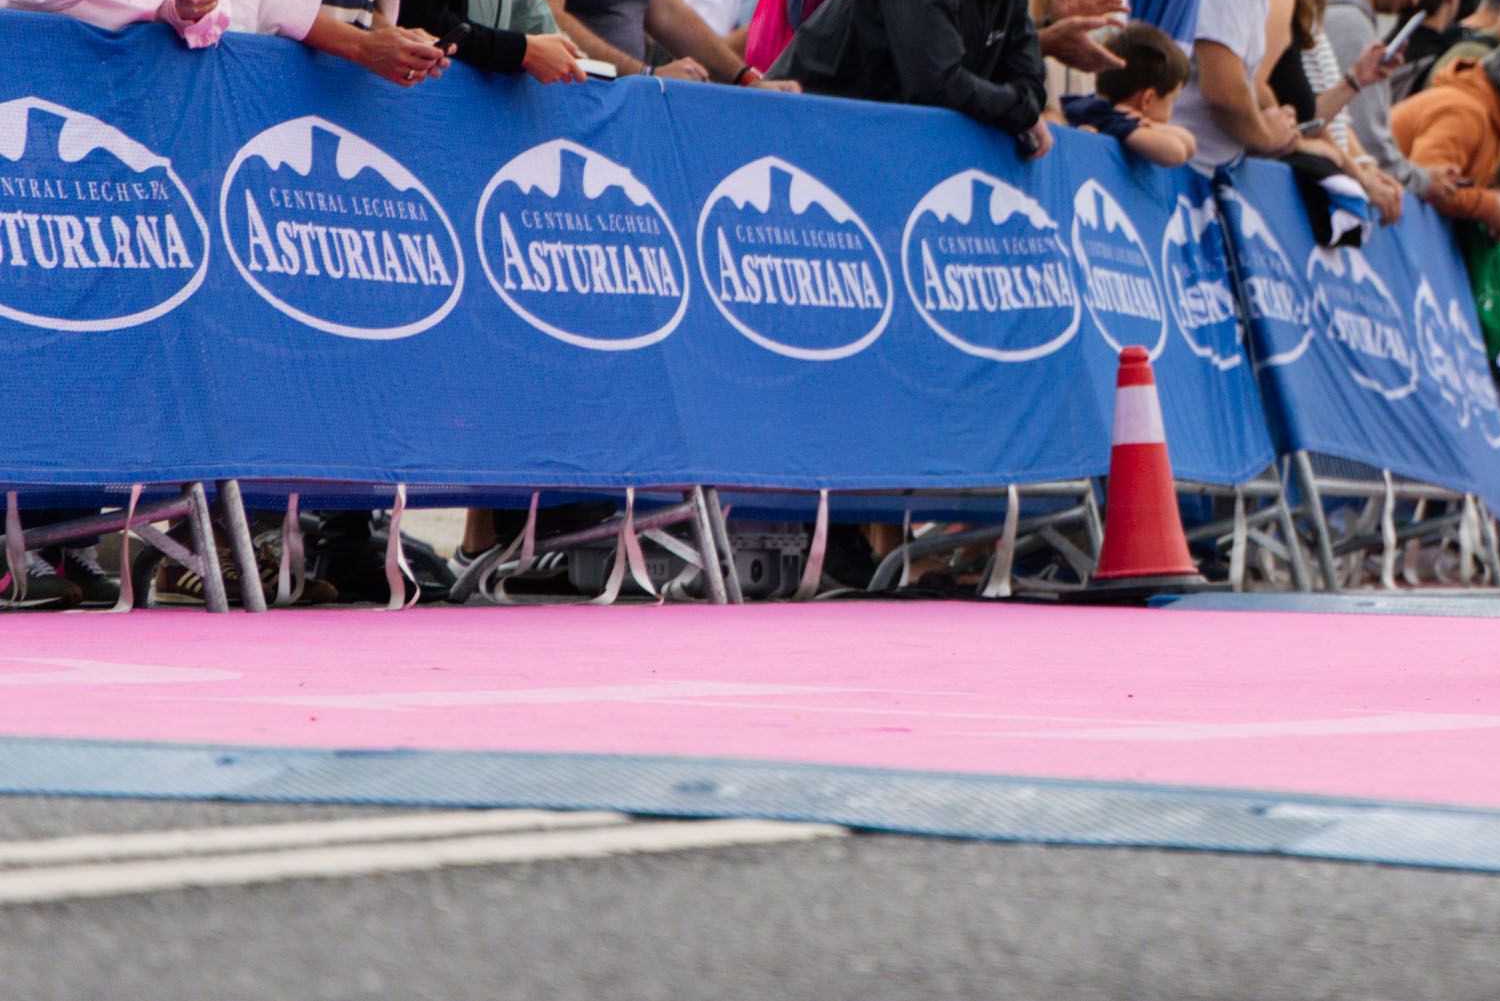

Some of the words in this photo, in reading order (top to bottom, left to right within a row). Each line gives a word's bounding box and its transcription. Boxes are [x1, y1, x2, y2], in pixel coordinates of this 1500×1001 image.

[270, 187, 344, 213] CENTRAL
[354, 195, 428, 221] LECHERA
[521, 209, 592, 232] CENTRAL
[0, 210, 194, 269] TURIANA
[245, 188, 452, 286] ASTURIANA
[499, 211, 681, 297] ASTURIANA
[735, 224, 799, 247] CENTRAL
[802, 228, 863, 251] LECHERA
[938, 236, 1000, 255] CENTRAL
[717, 225, 884, 311] ASTURIANA
